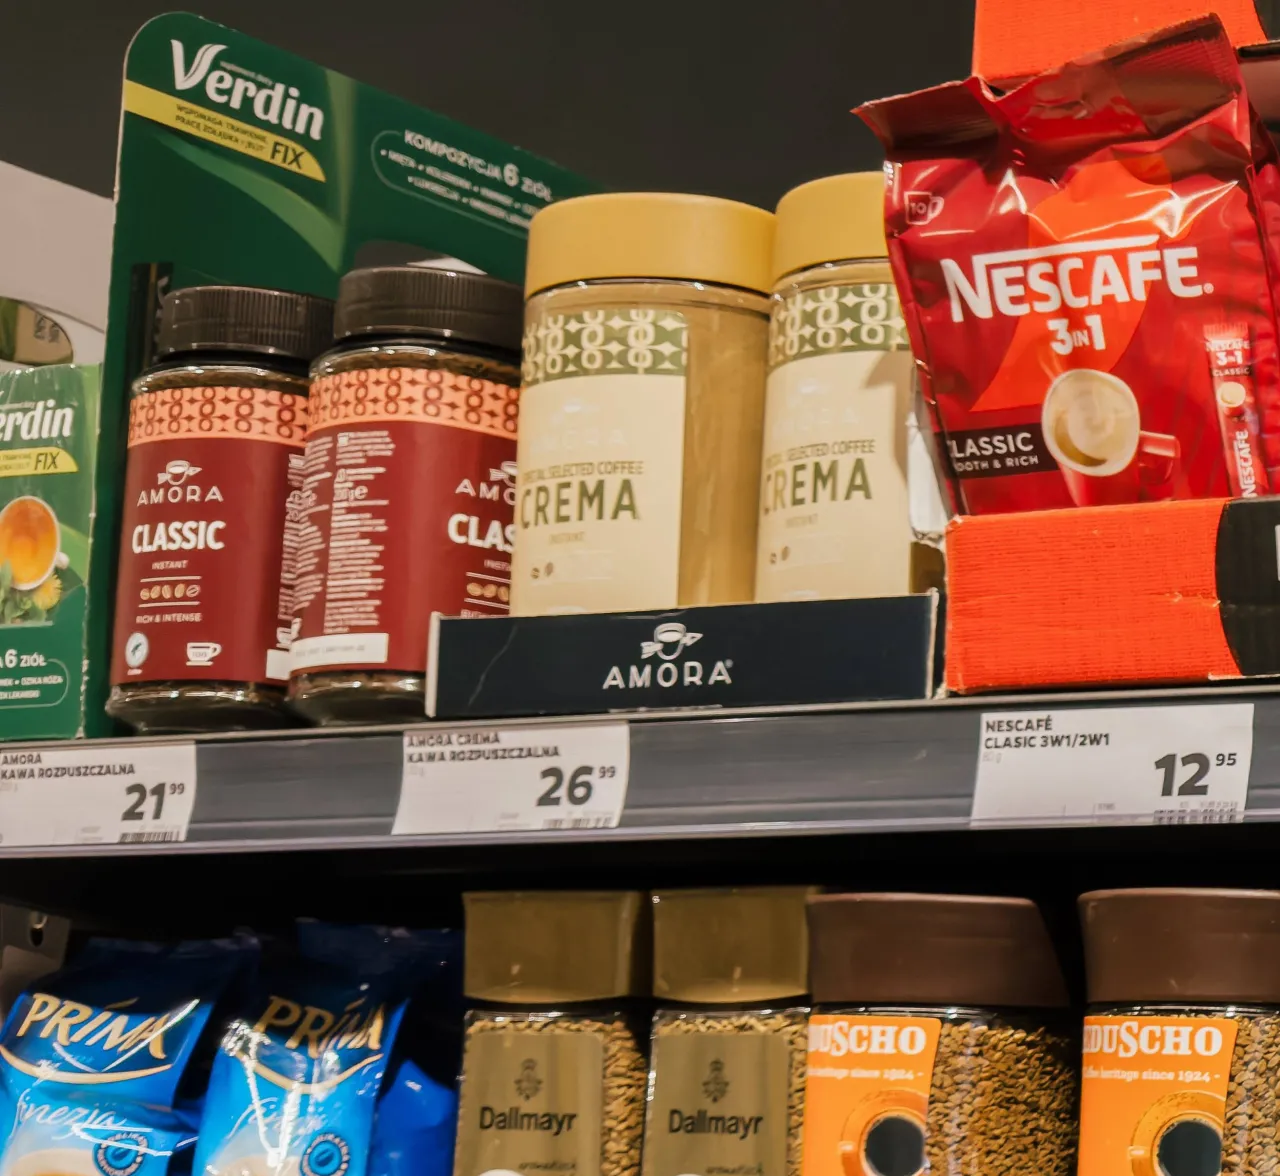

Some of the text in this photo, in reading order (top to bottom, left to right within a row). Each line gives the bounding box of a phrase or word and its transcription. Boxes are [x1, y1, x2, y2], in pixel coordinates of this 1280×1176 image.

[170, 39, 324, 140] Verdin
[270, 142, 303, 170] FIX
[503, 164, 520, 186] 6
[34, 452, 59, 470] FIX
[599, 460, 644, 475] COFFEE
[1005, 455, 1039, 467] RICH
[137, 485, 224, 507] AMORA
[763, 457, 873, 516] CREMA
[521, 478, 641, 530] CREMA
[132, 521, 226, 554] CLASSIC
[5, 649, 18, 668] 6
[602, 660, 732, 690] AMORA
[986, 715, 1053, 732] NESCAFÉ
[985, 733, 1109, 749] CLASIC 3W1/2W1
[1, 764, 135, 779] KAWA ROZPUSZCZALNA
[2, 754, 42, 765] AMORA
[536, 765, 594, 806] 26
[1155, 753, 1236, 796] 12 95
[121, 782, 185, 821] 21 99
[479, 1107, 577, 1136] Dallmayr
[668, 1110, 763, 1139] Dallmayr
